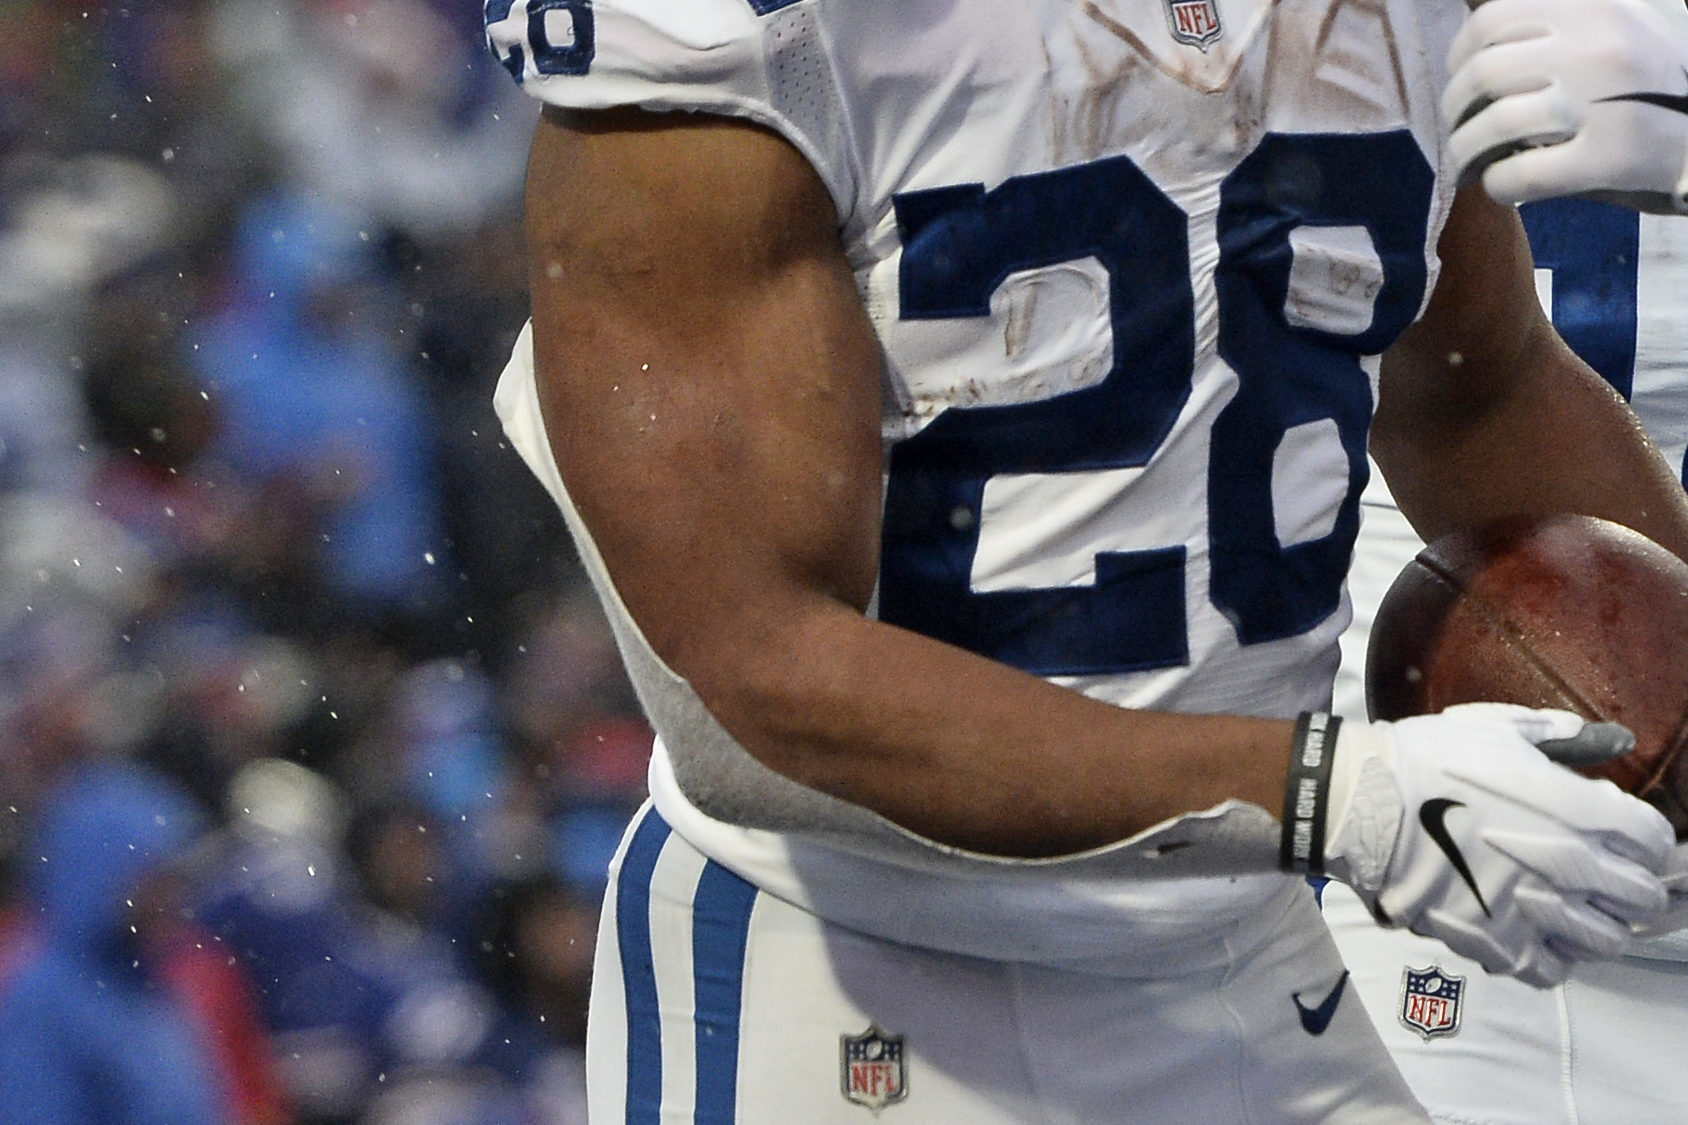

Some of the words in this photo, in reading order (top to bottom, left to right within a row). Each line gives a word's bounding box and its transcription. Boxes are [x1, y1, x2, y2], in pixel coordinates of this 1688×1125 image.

[1174, 3, 1217, 36] NFL
[879, 128, 1436, 675] 28
[1408, 995, 1452, 1028] NFL
[851, 1064, 897, 1096] NFL
